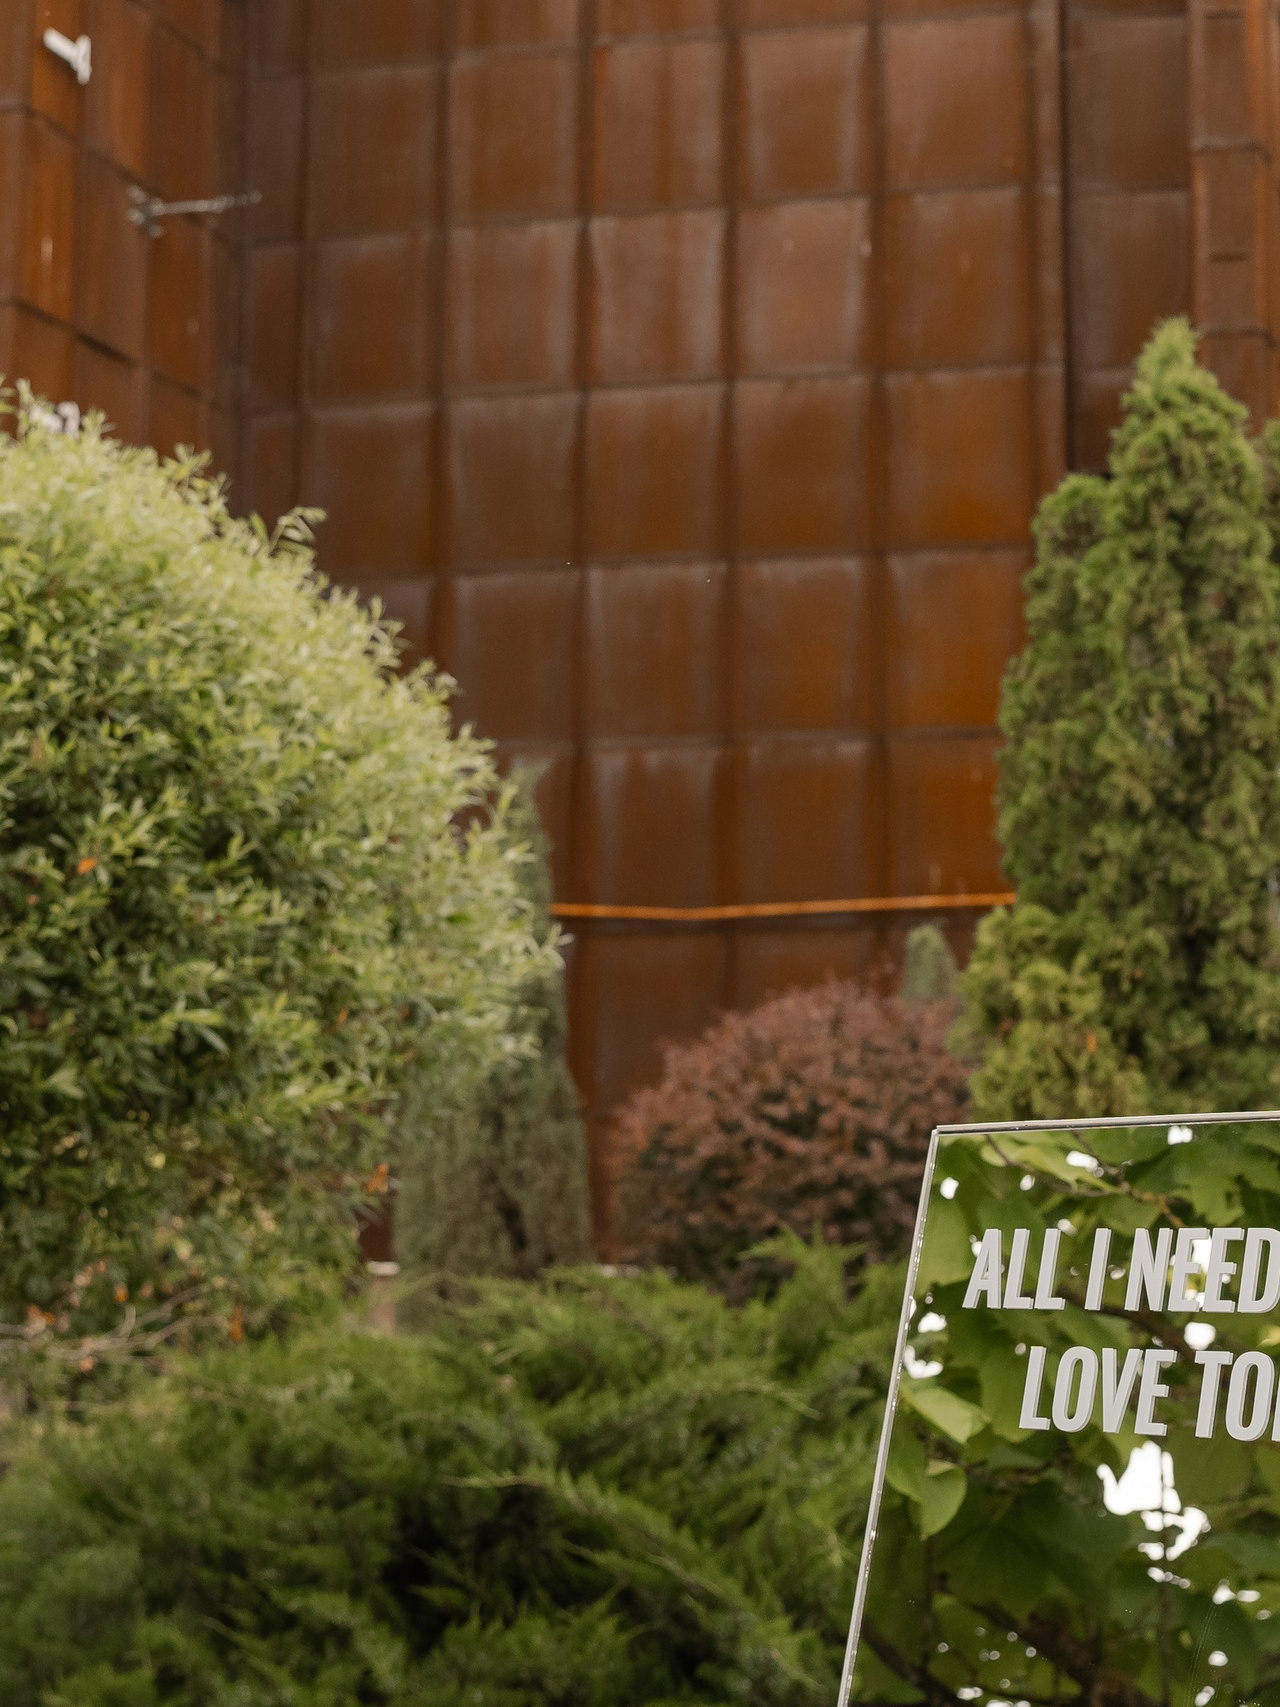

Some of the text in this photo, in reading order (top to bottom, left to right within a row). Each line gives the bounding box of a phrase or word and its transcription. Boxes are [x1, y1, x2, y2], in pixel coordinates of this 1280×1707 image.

[962, 1228, 1066, 1310] ALL
[1085, 1228, 1111, 1311] I
[1019, 1346, 1178, 1436] LOVE
